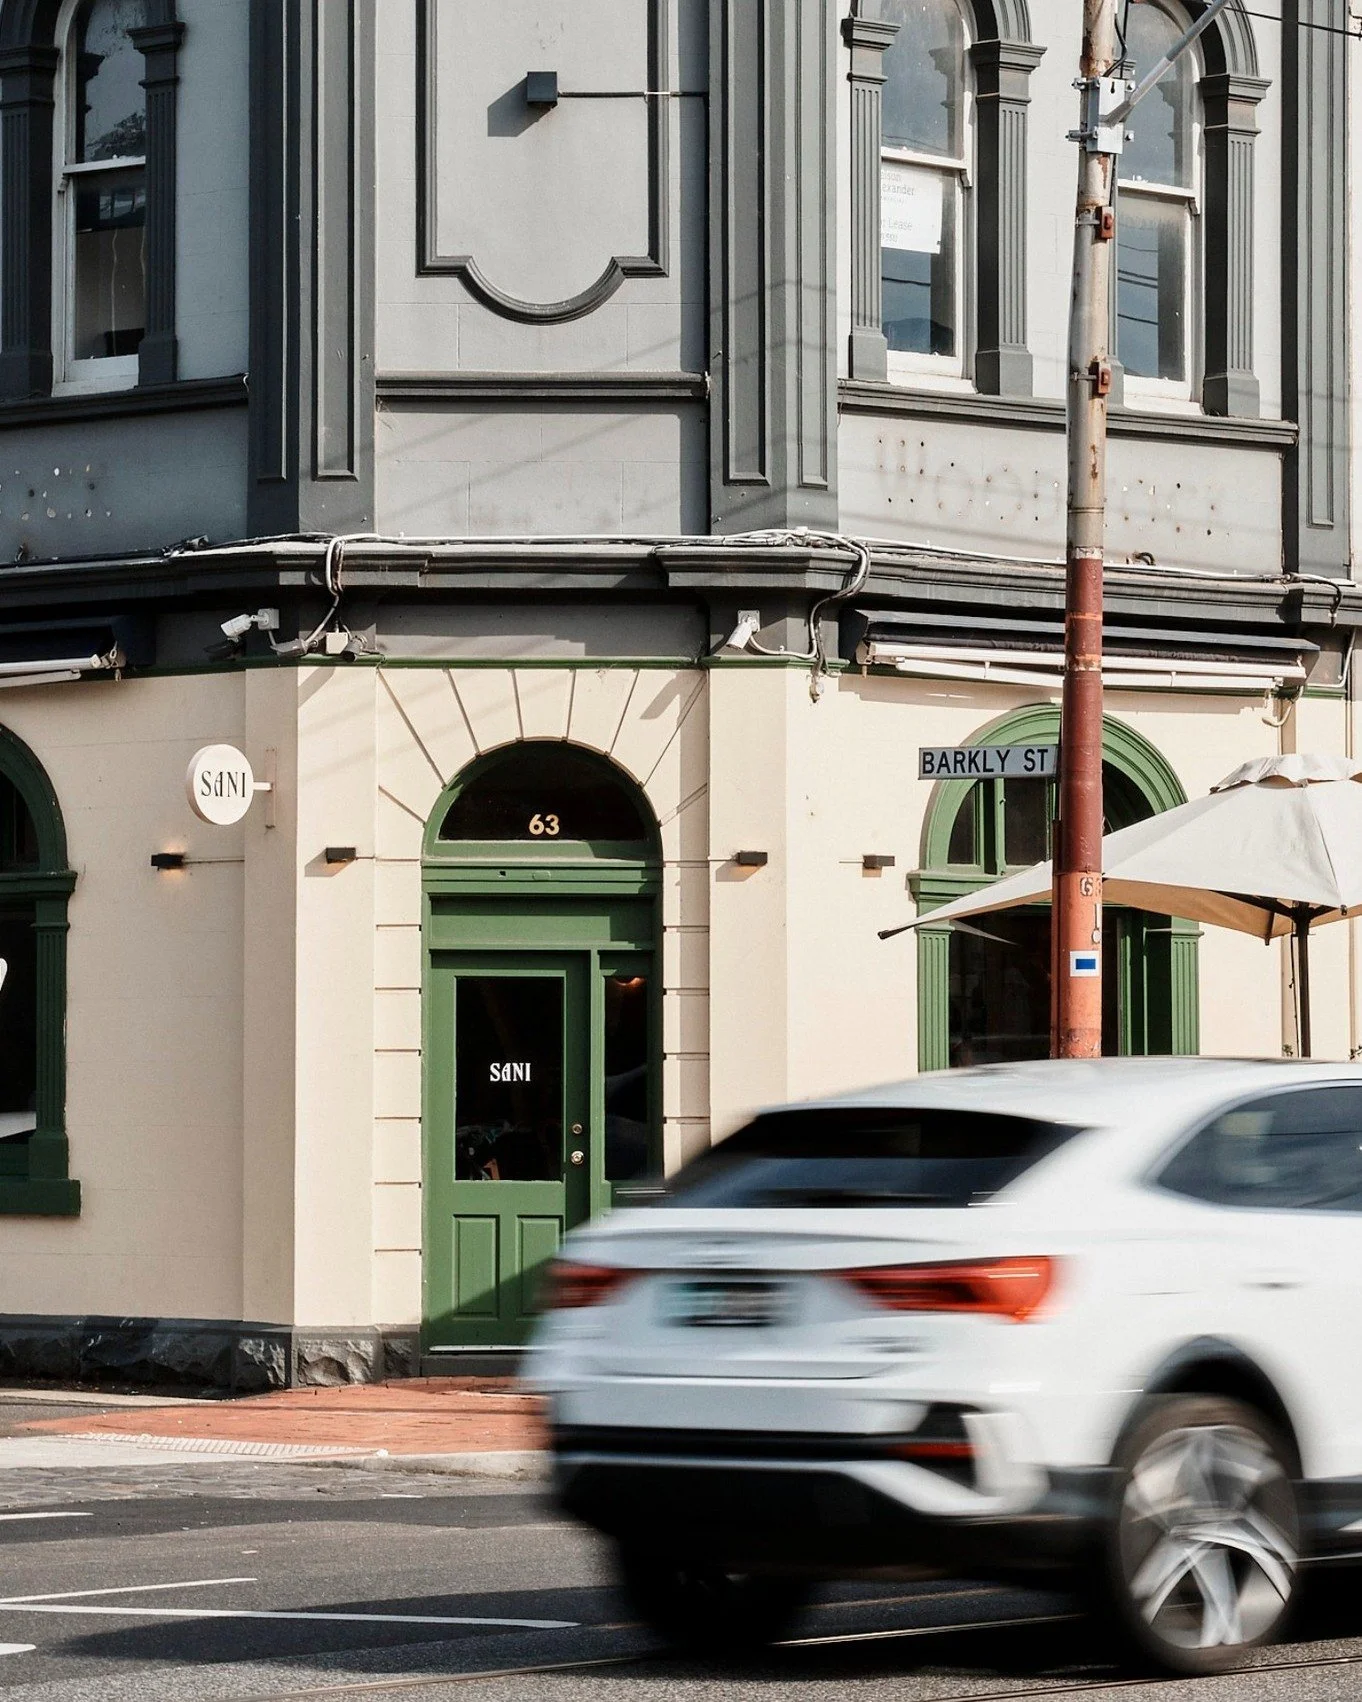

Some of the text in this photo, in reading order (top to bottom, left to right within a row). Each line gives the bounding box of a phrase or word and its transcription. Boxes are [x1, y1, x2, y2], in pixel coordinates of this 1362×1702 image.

[921, 748, 1049, 775] BARKLY ST
[528, 813, 560, 836] 63
